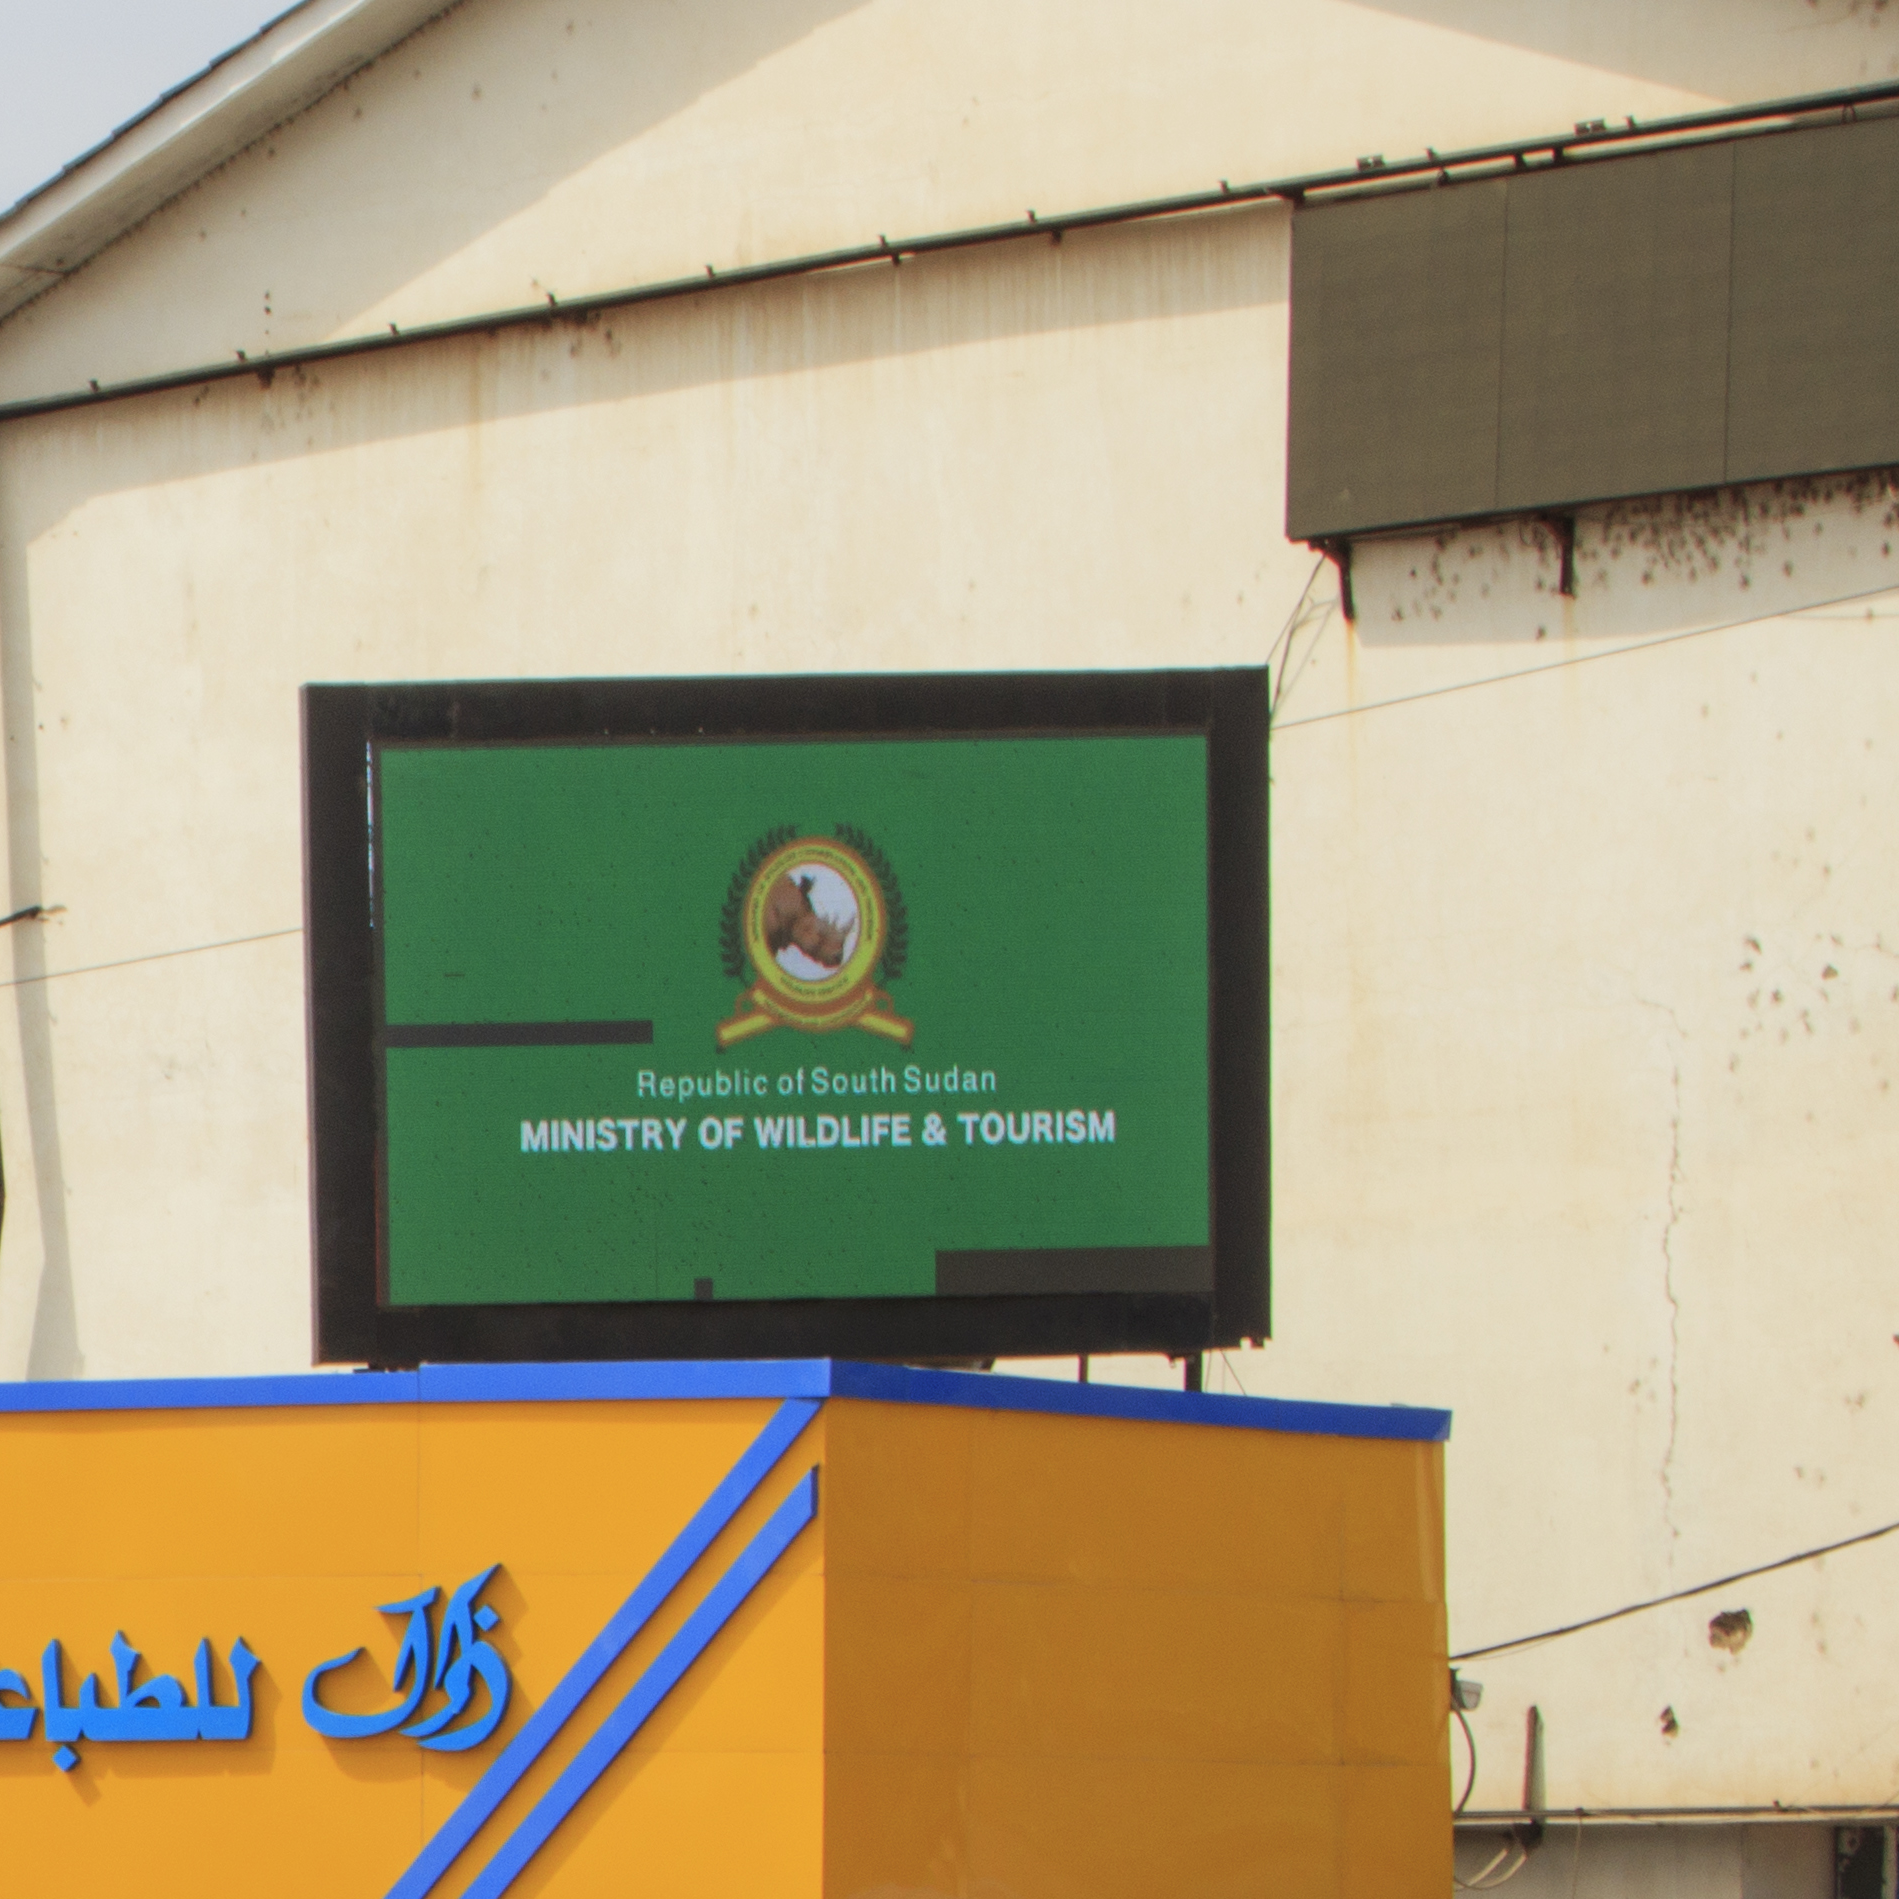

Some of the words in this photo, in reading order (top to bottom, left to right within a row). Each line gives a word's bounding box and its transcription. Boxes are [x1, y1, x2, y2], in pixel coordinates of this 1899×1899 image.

[638, 1070, 768, 1102] Republic
[778, 1069, 805, 1094] of
[810, 1066, 897, 1094] South
[903, 1064, 997, 1093] Sudan
[521, 1117, 688, 1152] MINISTRY
[698, 1116, 745, 1150] OF
[754, 1113, 913, 1148] WILDLIFE
[922, 1112, 948, 1146] &
[958, 1109, 1117, 1145] TOURISM
